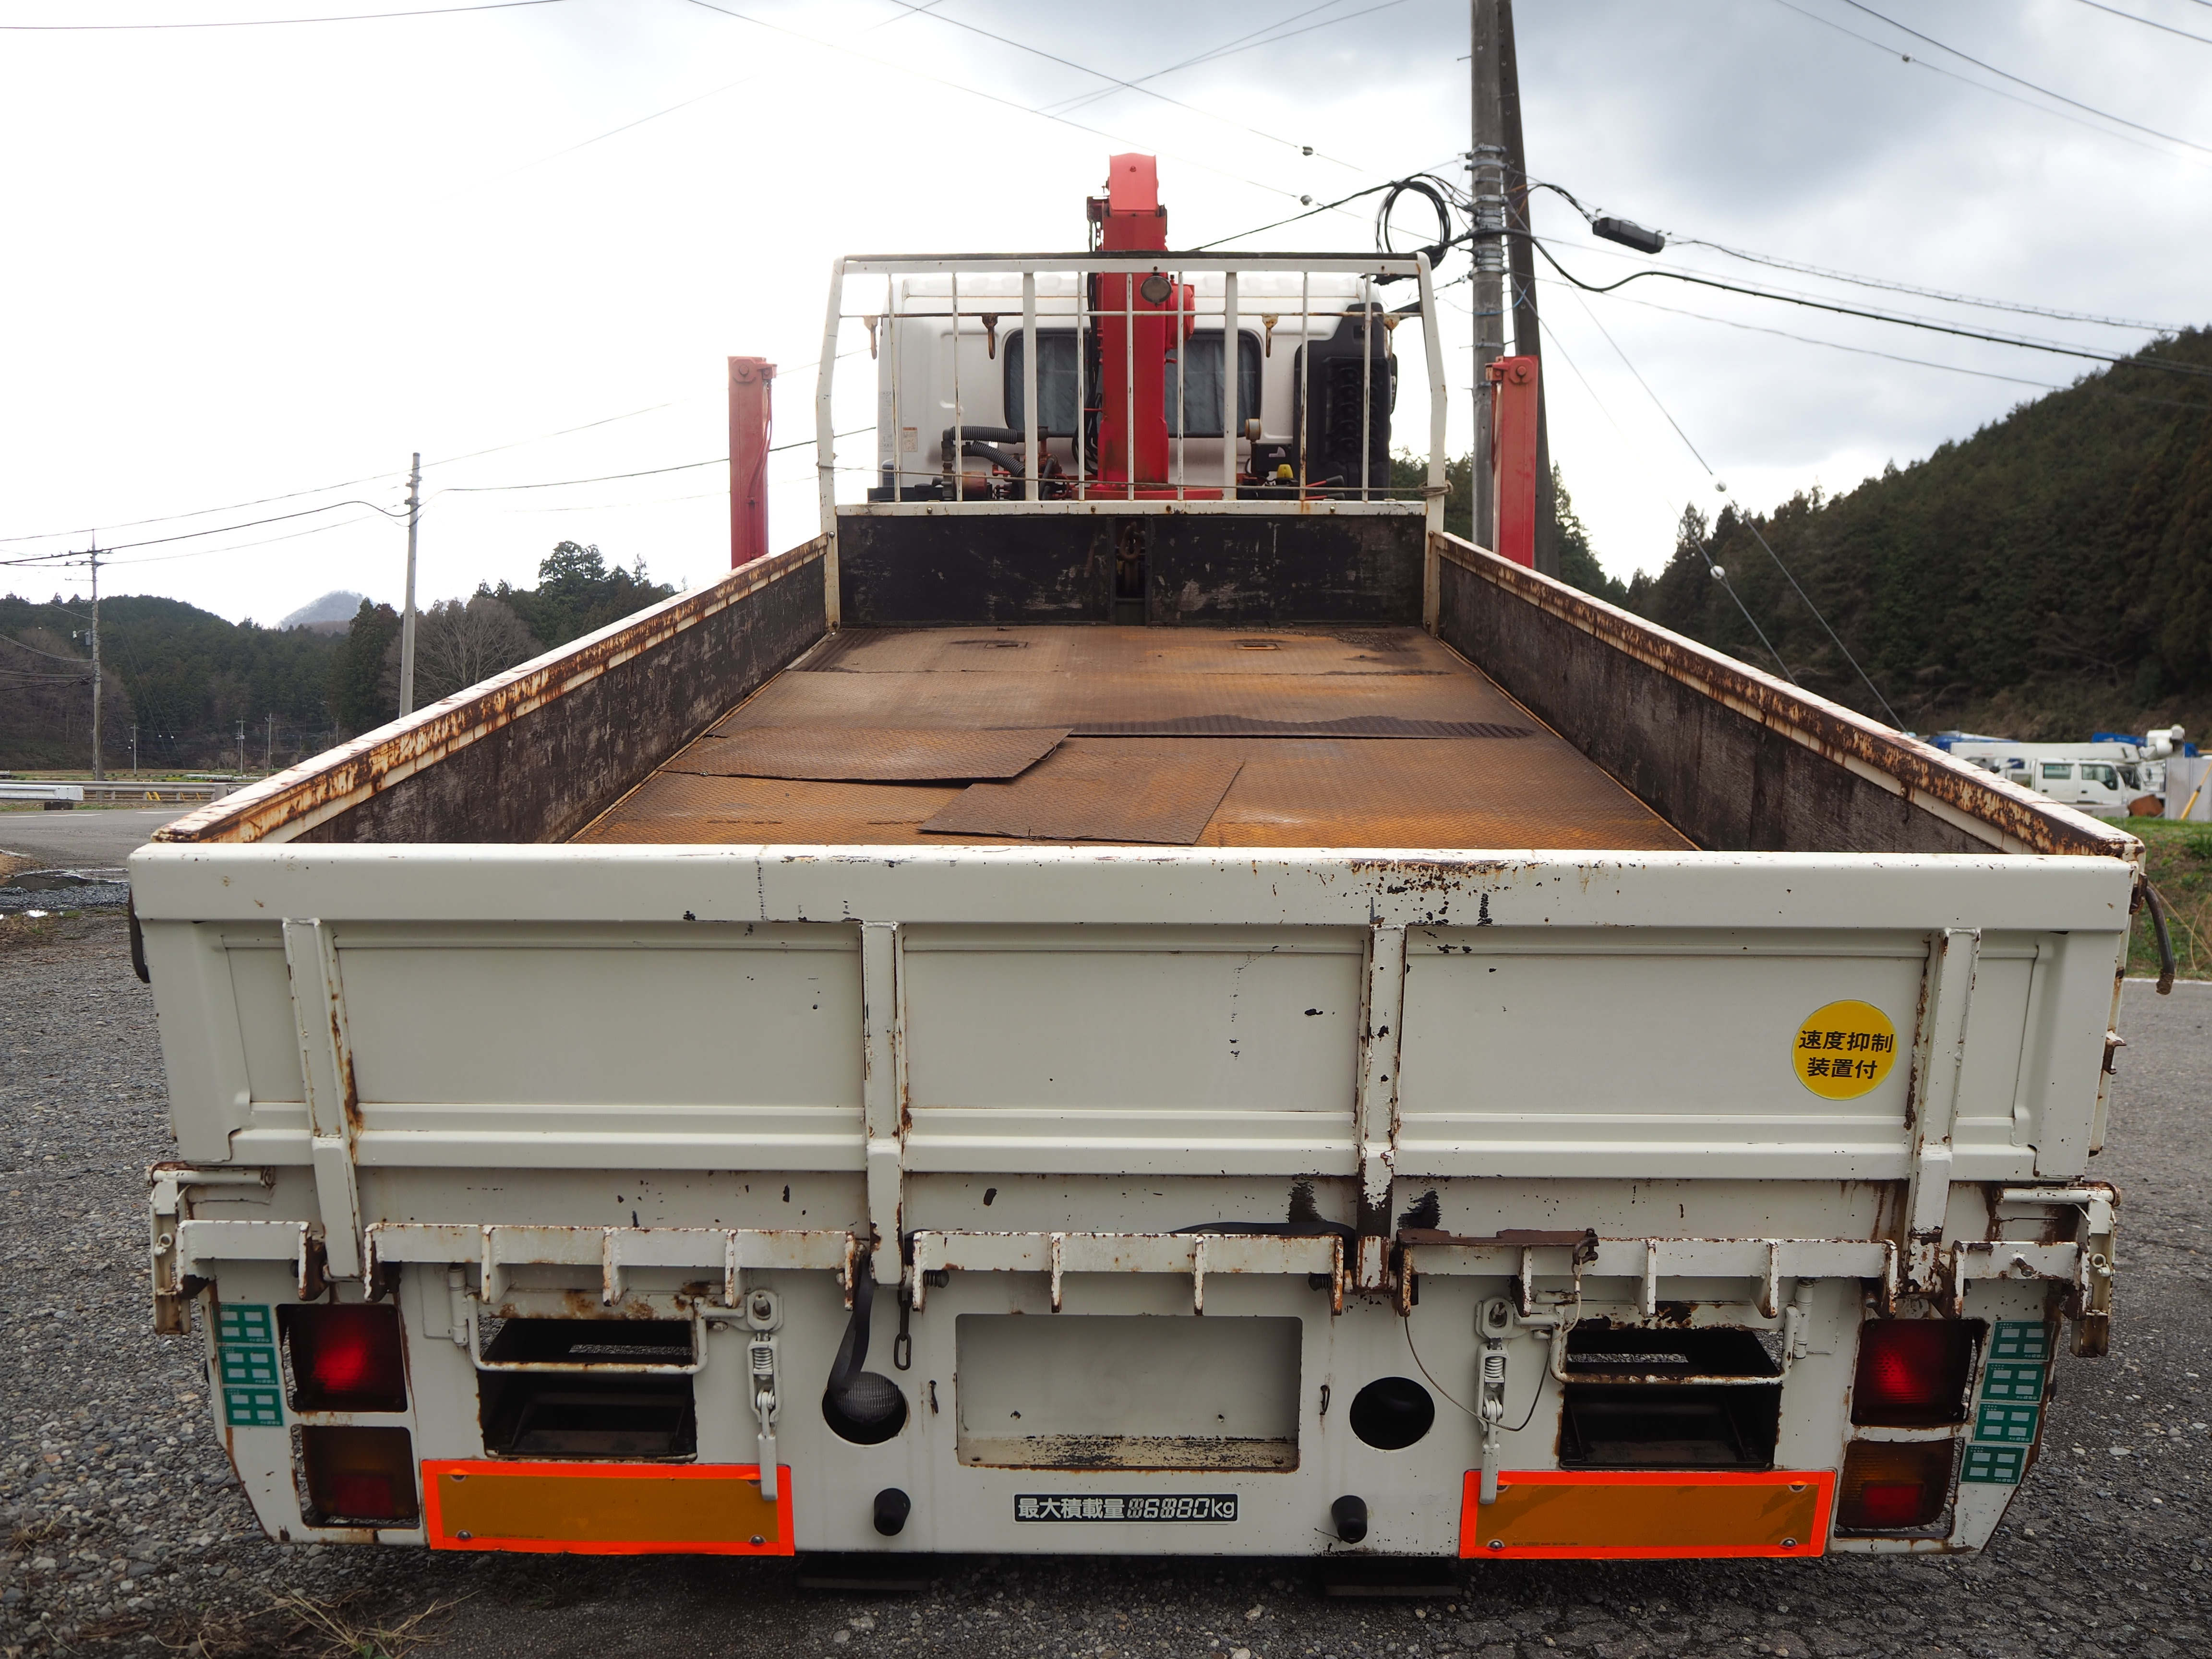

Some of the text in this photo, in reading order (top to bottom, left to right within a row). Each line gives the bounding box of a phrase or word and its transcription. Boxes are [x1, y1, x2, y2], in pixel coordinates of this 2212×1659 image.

[1799, 1030, 1894, 1053] 速度抑制
[1807, 1057, 1877, 1079] 装置付
